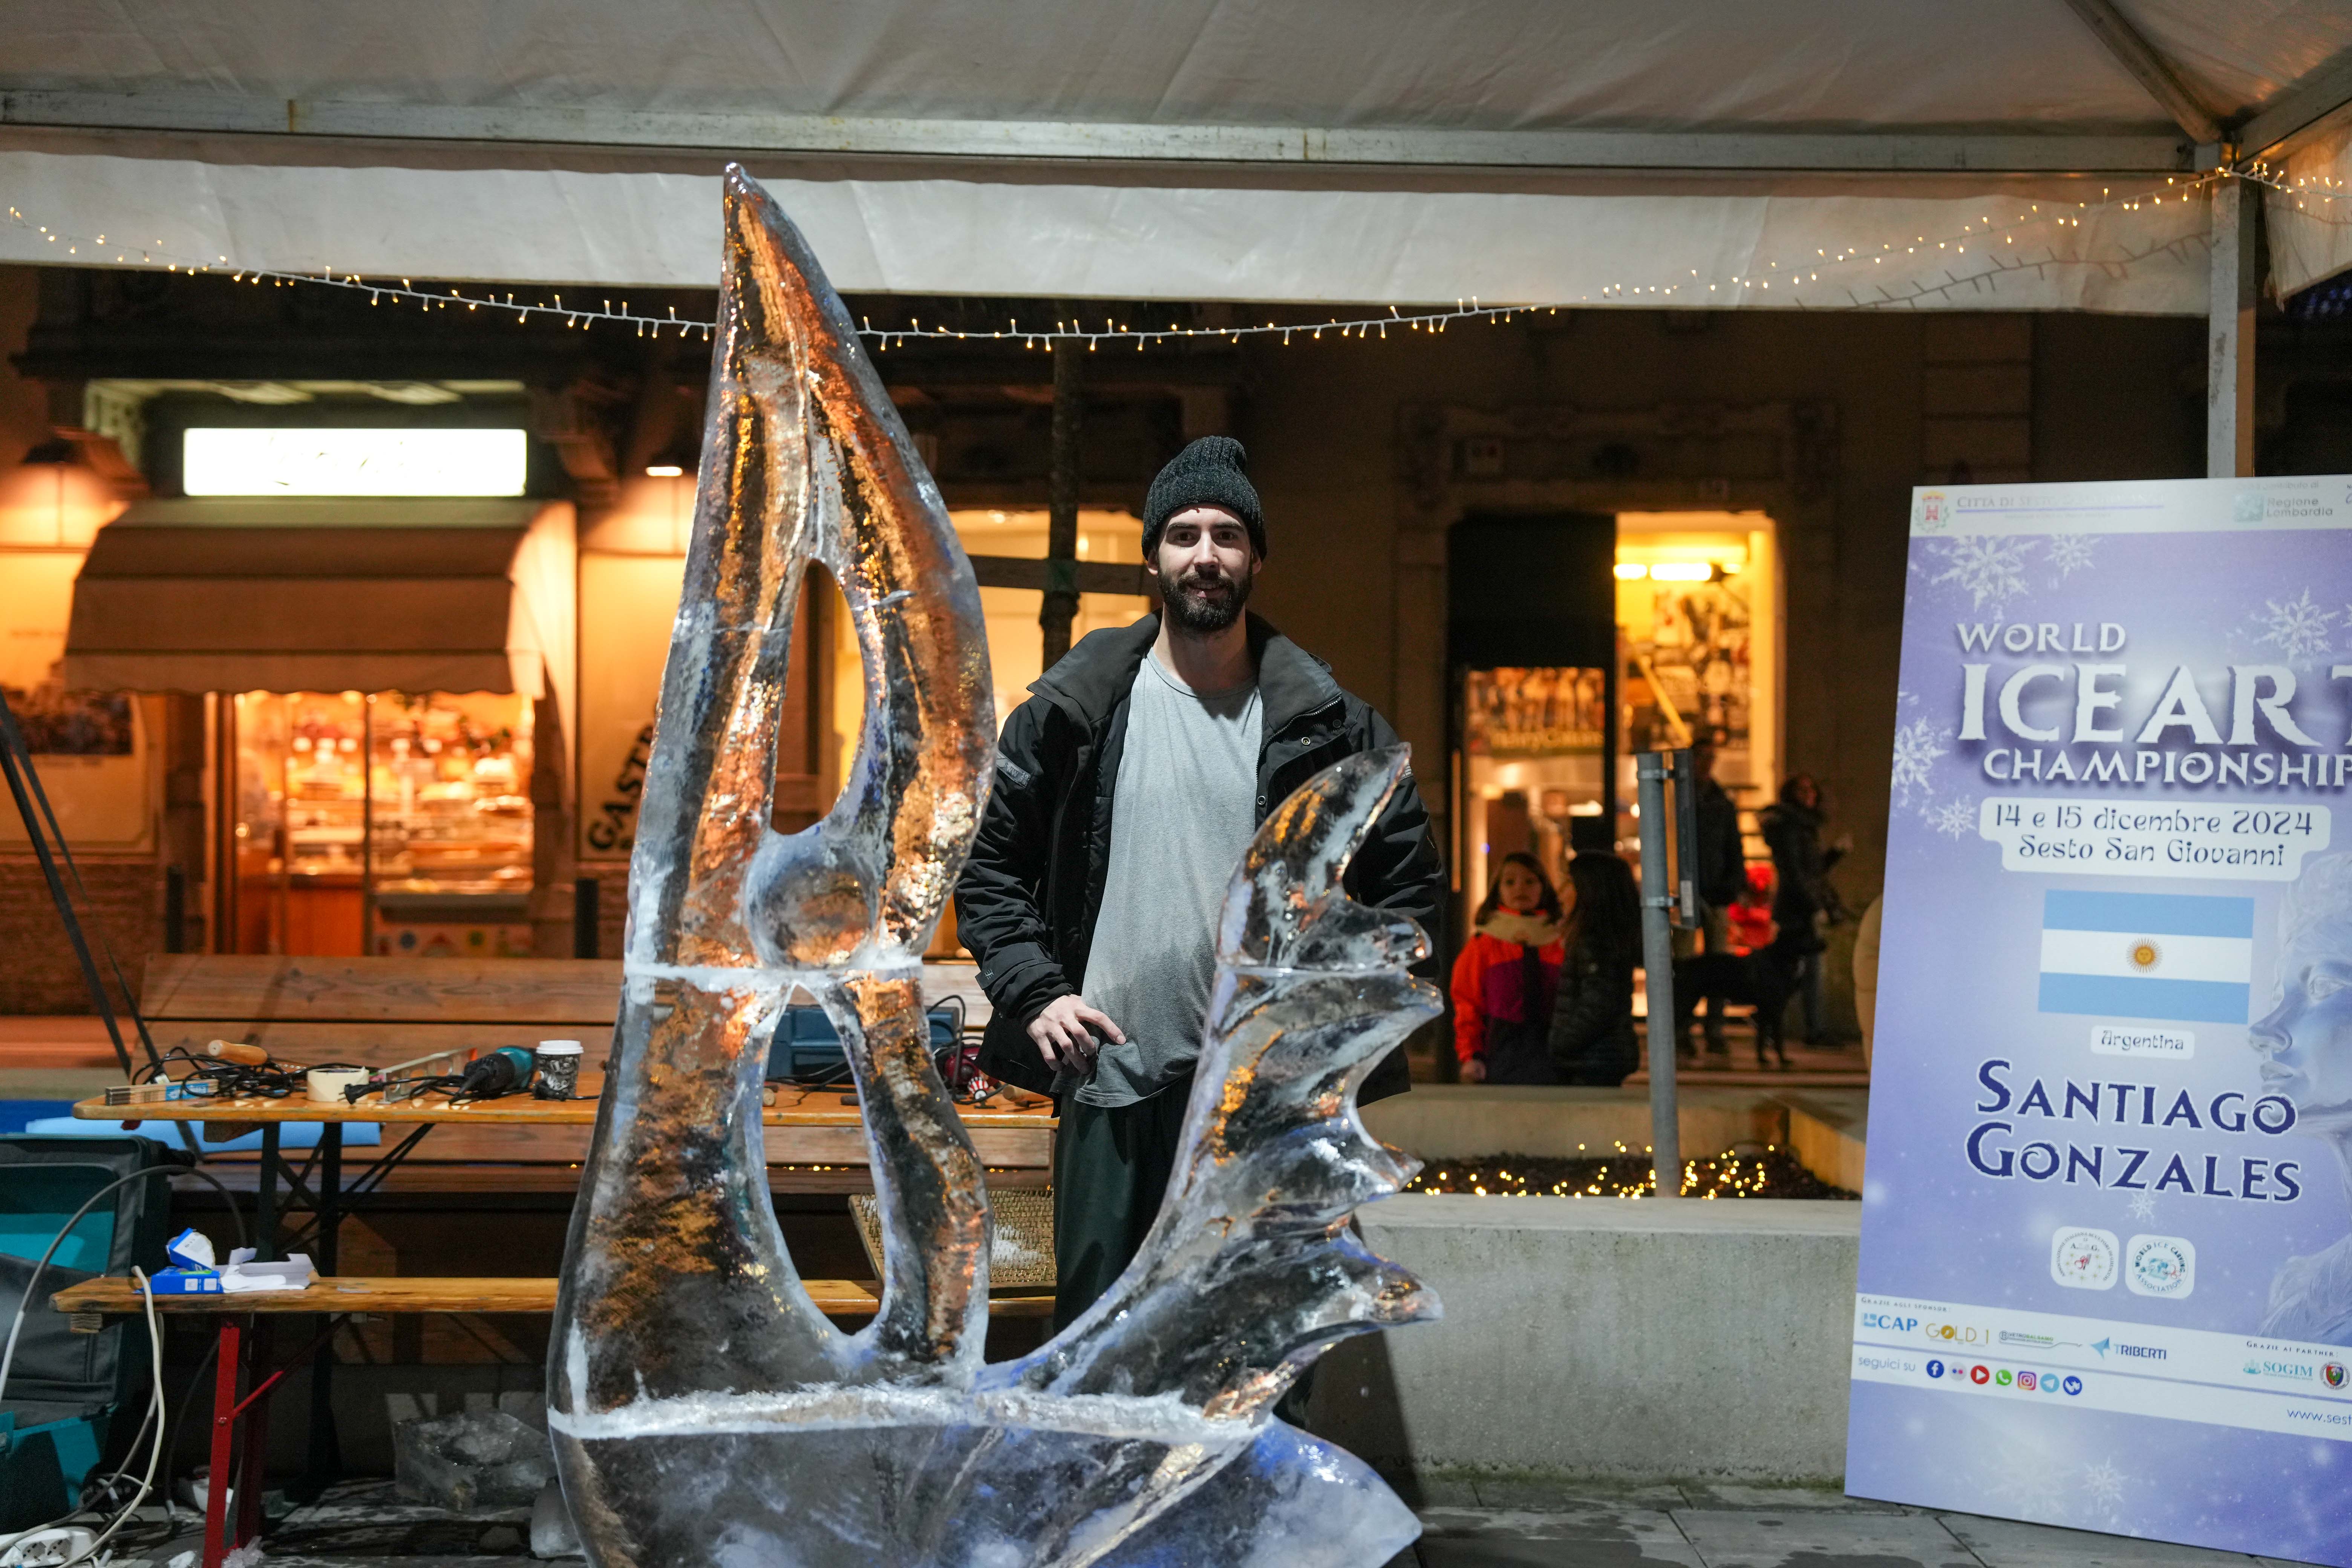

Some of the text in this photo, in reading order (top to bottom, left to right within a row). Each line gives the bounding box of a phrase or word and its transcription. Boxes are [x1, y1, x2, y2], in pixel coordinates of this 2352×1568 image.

[2267, 498, 2319, 507] Regione
[2266, 507, 2333, 517] Lombardia
[1956, 623, 2126, 652] WORLD
[1983, 747, 2352, 787] CHAMPIONSHIP
[1995, 804, 2313, 836] 14 e 15 dicembre 2024
[2018, 834, 2284, 867] Sesto San Giovanni
[2101, 1030, 2185, 1052] Argentina
[1976, 1058, 2298, 1135] SANTIAGO
[1965, 1121, 2302, 1202] GONZALES
[2135, 1244, 2152, 1267] WORLD
[2170, 1246, 2186, 1273] CARVING
[2136, 1274, 2182, 1292] ASSOCIATION
[1861, 1297, 1890, 1305] GRAZIE
[1878, 1314, 1918, 1332] CAP
[2113, 1343, 2167, 1360] TRIBERTI
[2246, 1340, 2279, 1350] GRAZIE
[1857, 1356, 1916, 1371] seguici su
[2263, 1360, 2313, 1377] SOGIM
